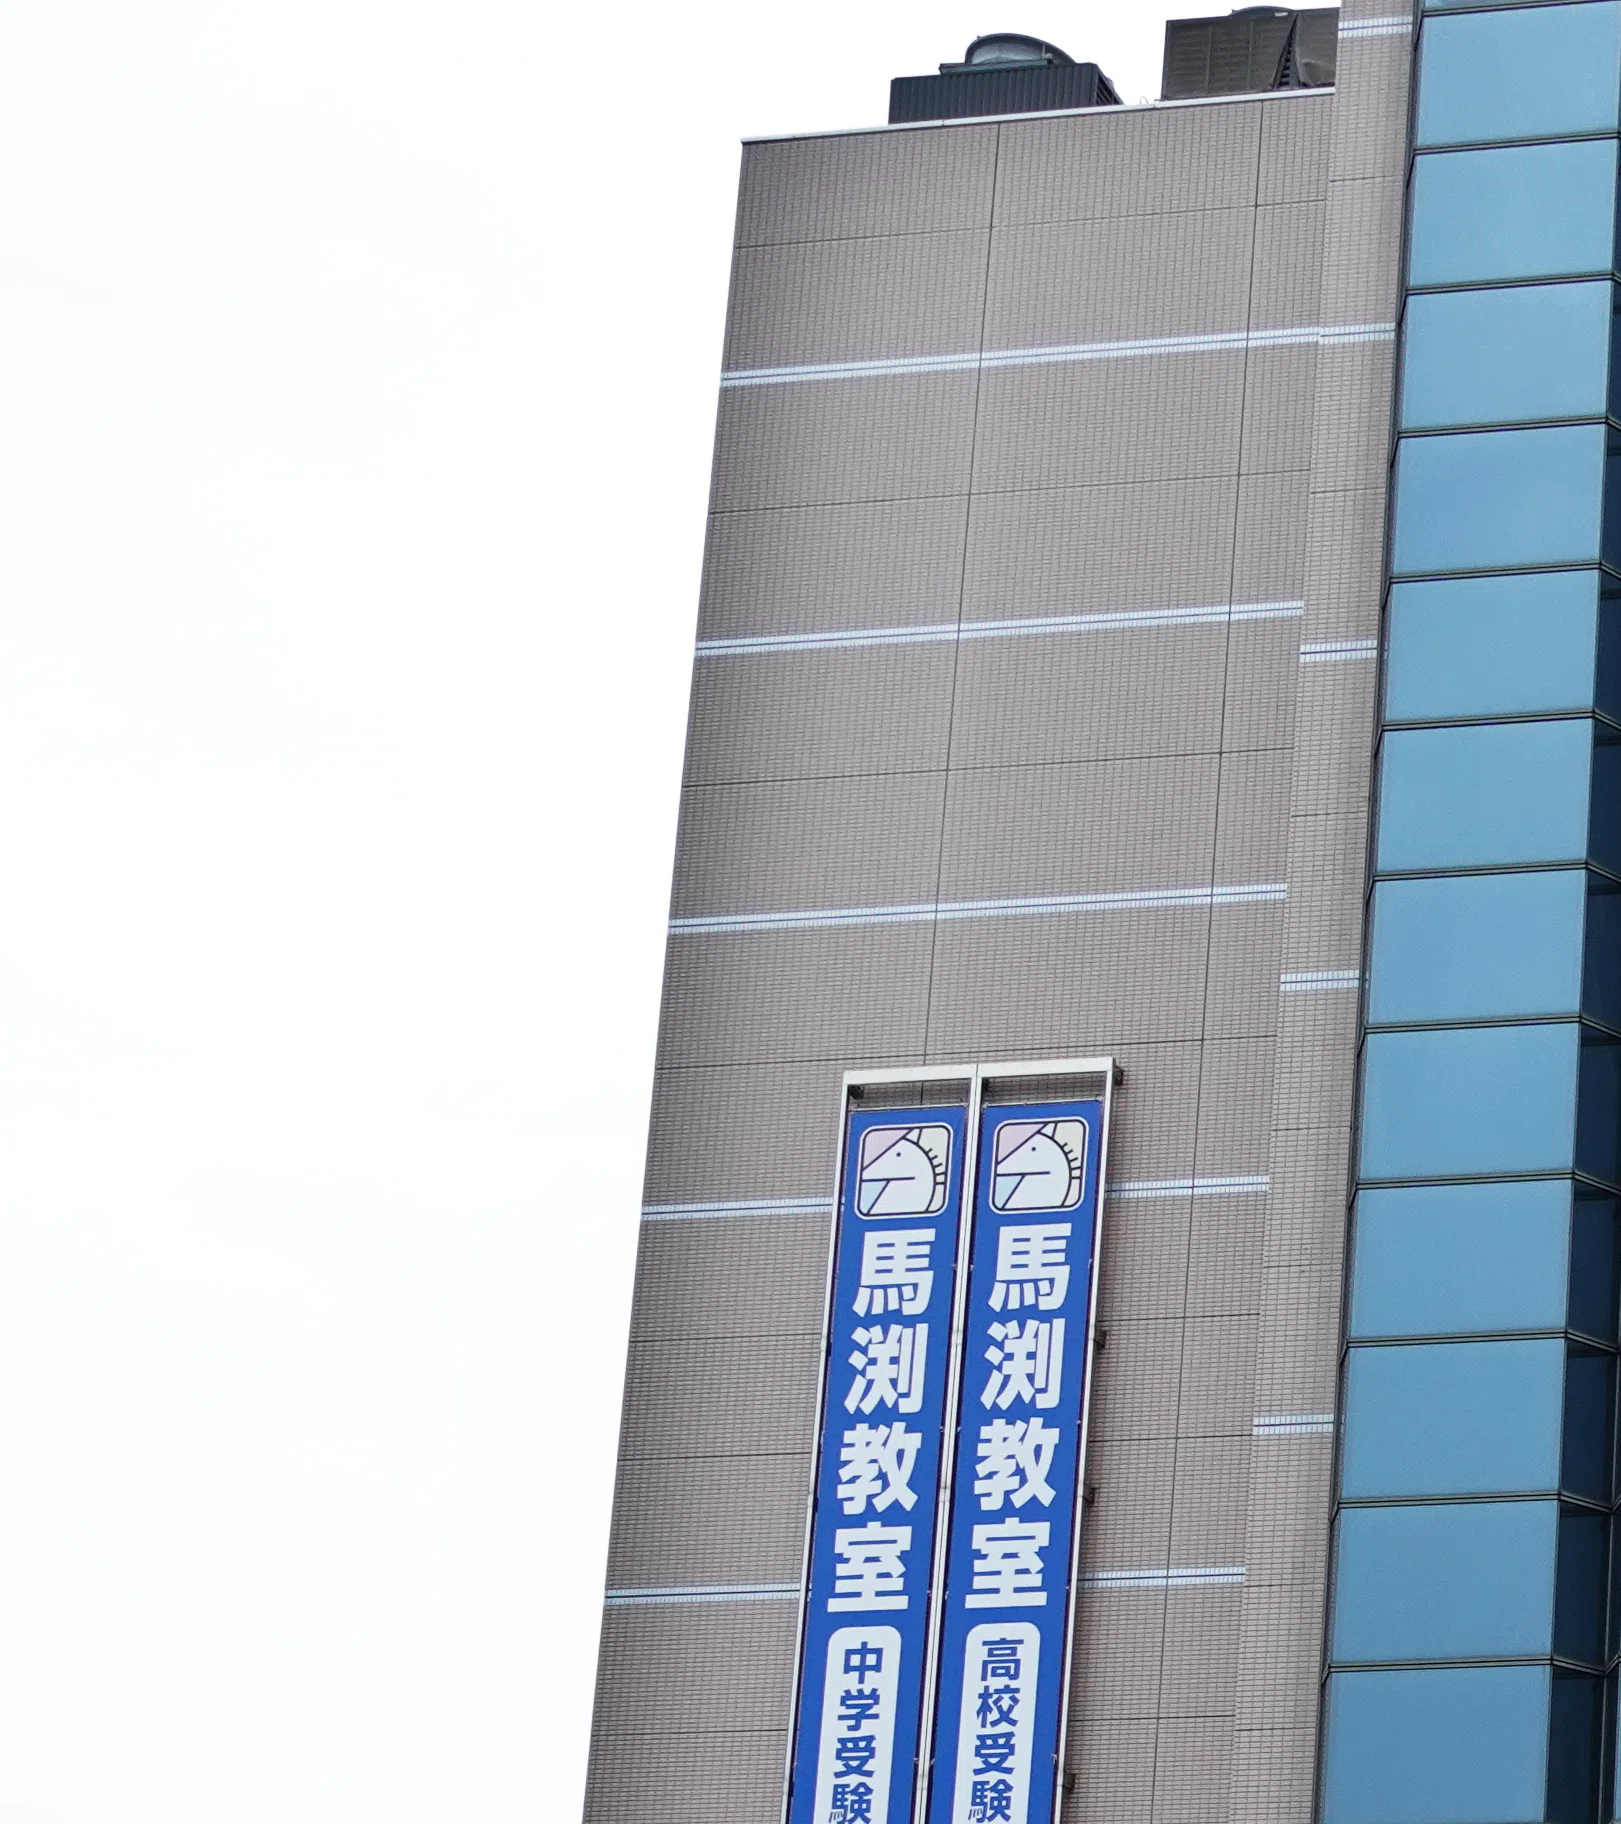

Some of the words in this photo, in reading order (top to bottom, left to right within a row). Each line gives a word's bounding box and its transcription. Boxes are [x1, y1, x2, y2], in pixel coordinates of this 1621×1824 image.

[827, 1228, 936, 1613] 馬渕教室
[964, 1222, 1073, 1609] 馬渕教室
